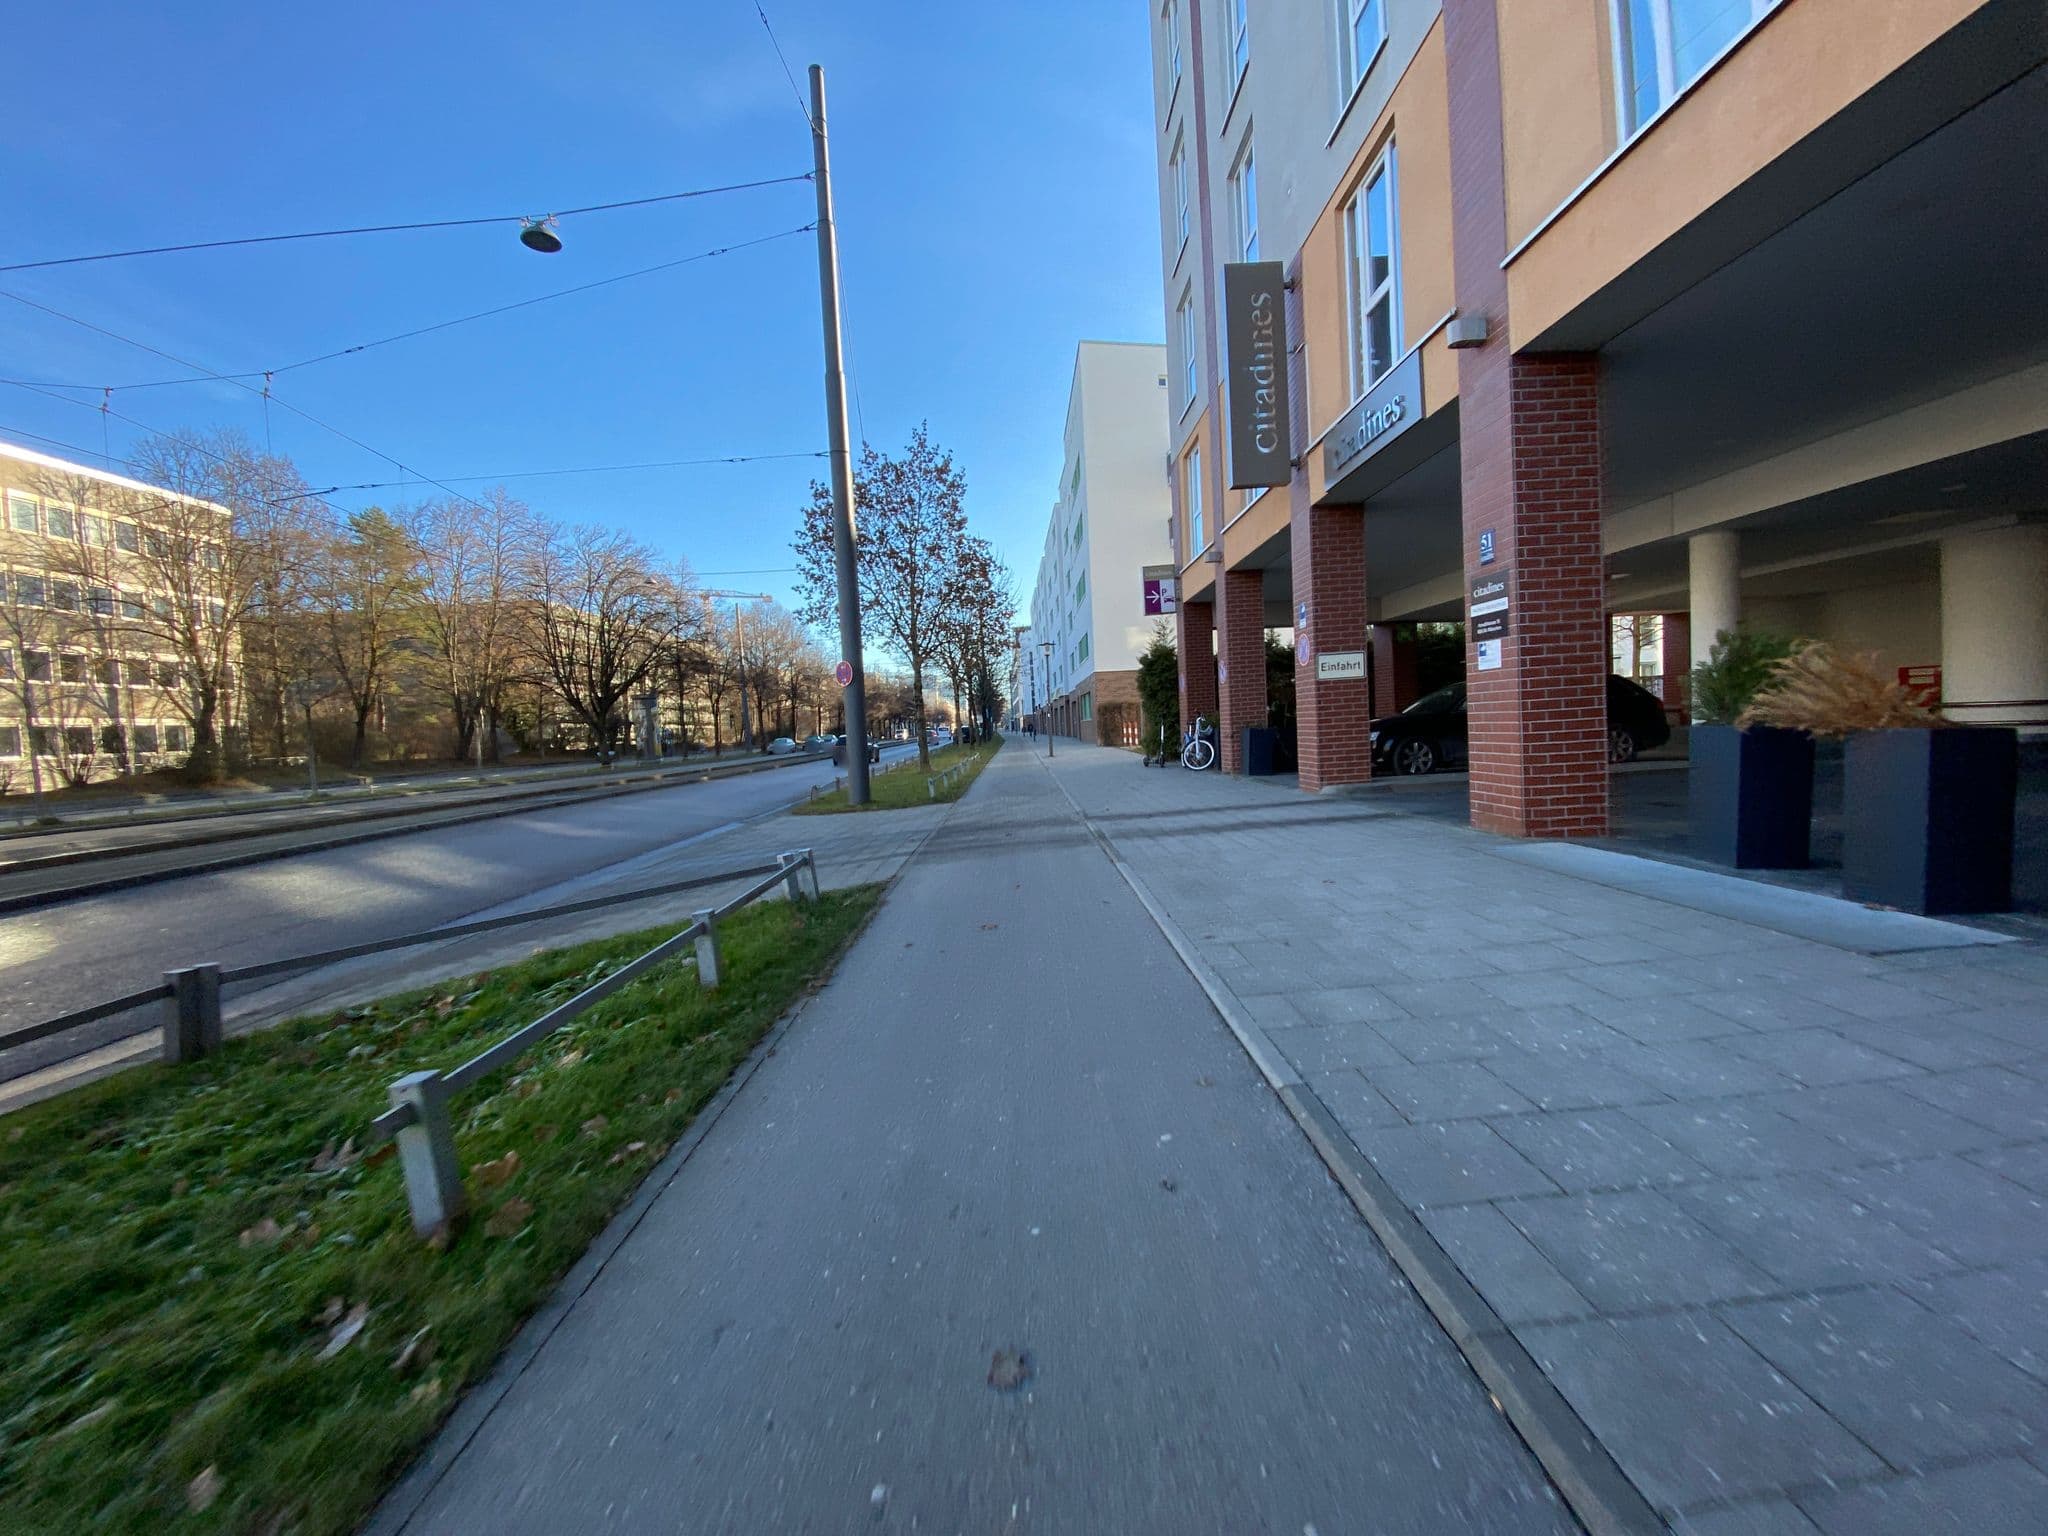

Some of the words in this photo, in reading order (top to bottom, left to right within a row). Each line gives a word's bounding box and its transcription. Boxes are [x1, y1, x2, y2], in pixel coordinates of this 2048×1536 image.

[1247, 291, 1279, 454] citadines
[1481, 532, 1493, 550] 51
[1320, 660, 1361, 672] Einfahrt
